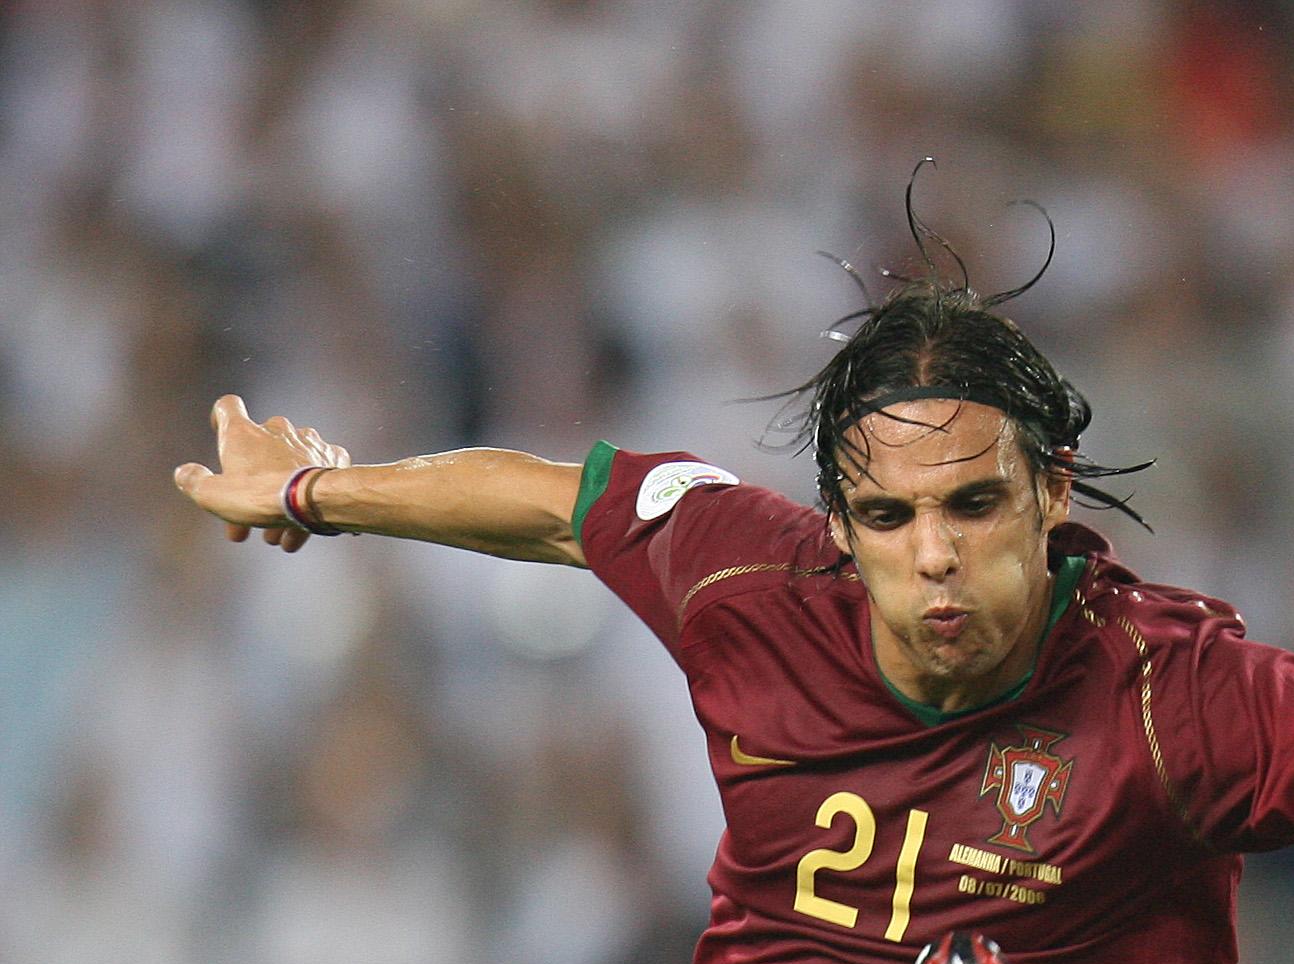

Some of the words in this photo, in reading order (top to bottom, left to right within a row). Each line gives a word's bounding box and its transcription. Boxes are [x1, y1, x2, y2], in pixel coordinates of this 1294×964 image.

[794, 791, 928, 942] 21
[948, 843, 1001, 874] ALEMANHA
[1009, 860, 1062, 886] PORTUGAL
